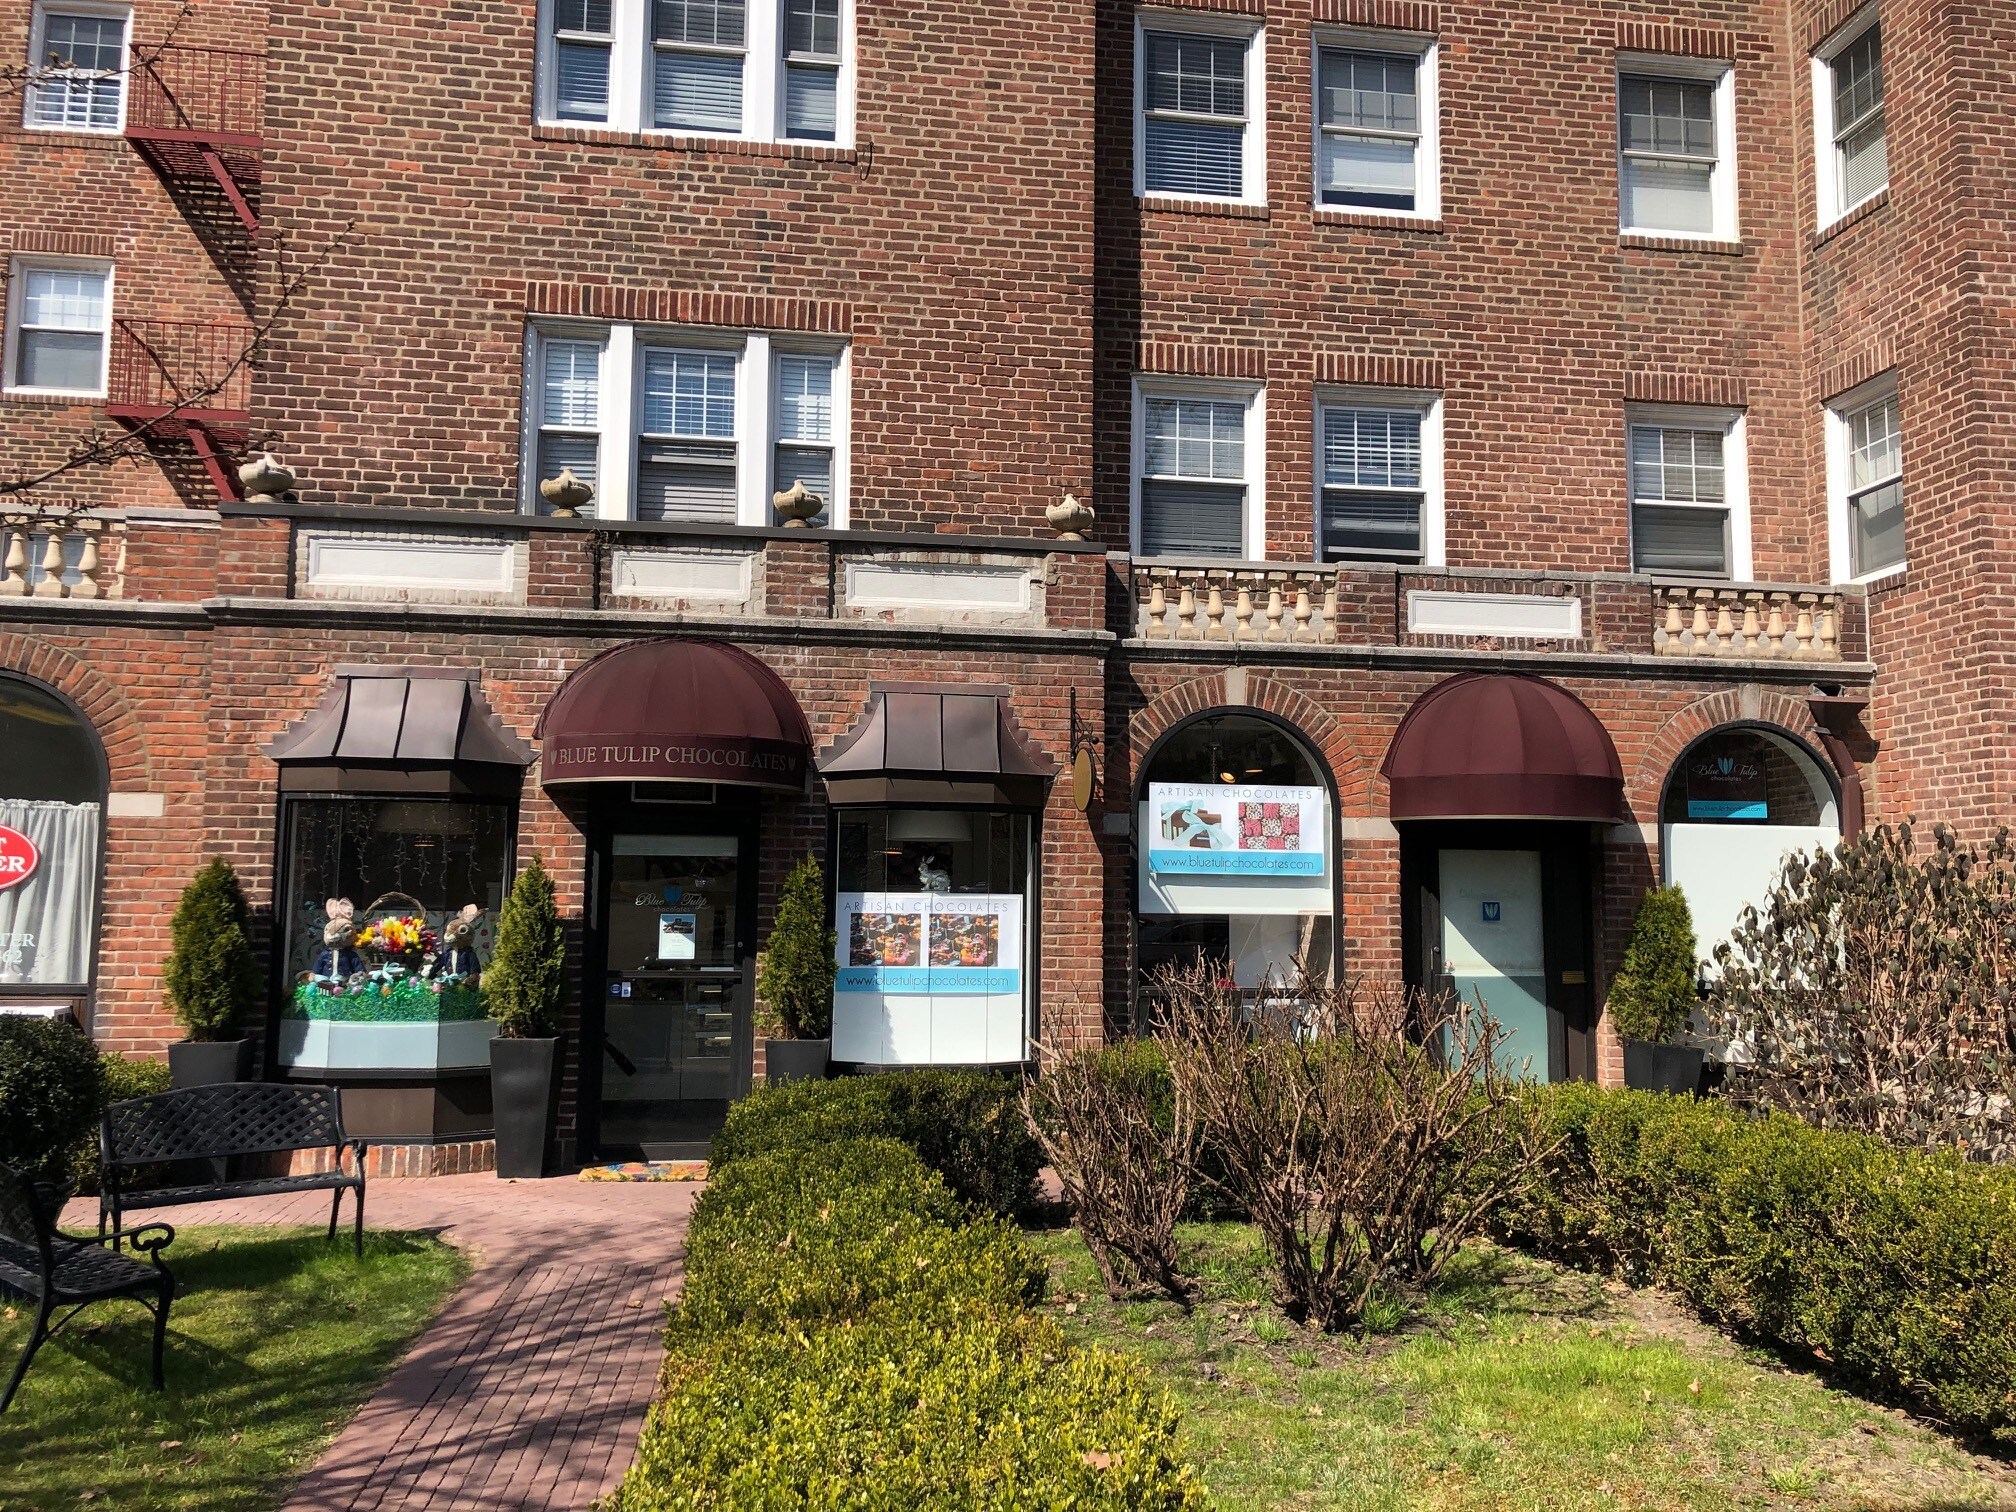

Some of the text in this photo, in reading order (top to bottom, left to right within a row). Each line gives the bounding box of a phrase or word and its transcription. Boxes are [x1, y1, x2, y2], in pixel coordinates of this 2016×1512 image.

[559, 746, 787, 771] BLUE TULIP CHOCOLATES
[1692, 764, 1760, 780] Blue Tulip
[1158, 787, 1313, 800] ARTISAN CHOCOLATES
[1161, 855, 1314, 871] www.bluetulipchocolates.com
[635, 892, 710, 909] Blue Tulip
[844, 901, 1009, 913] ARTISAN CHOCOLATES
[846, 973, 1009, 990] www.bluetulipchocolates.com
